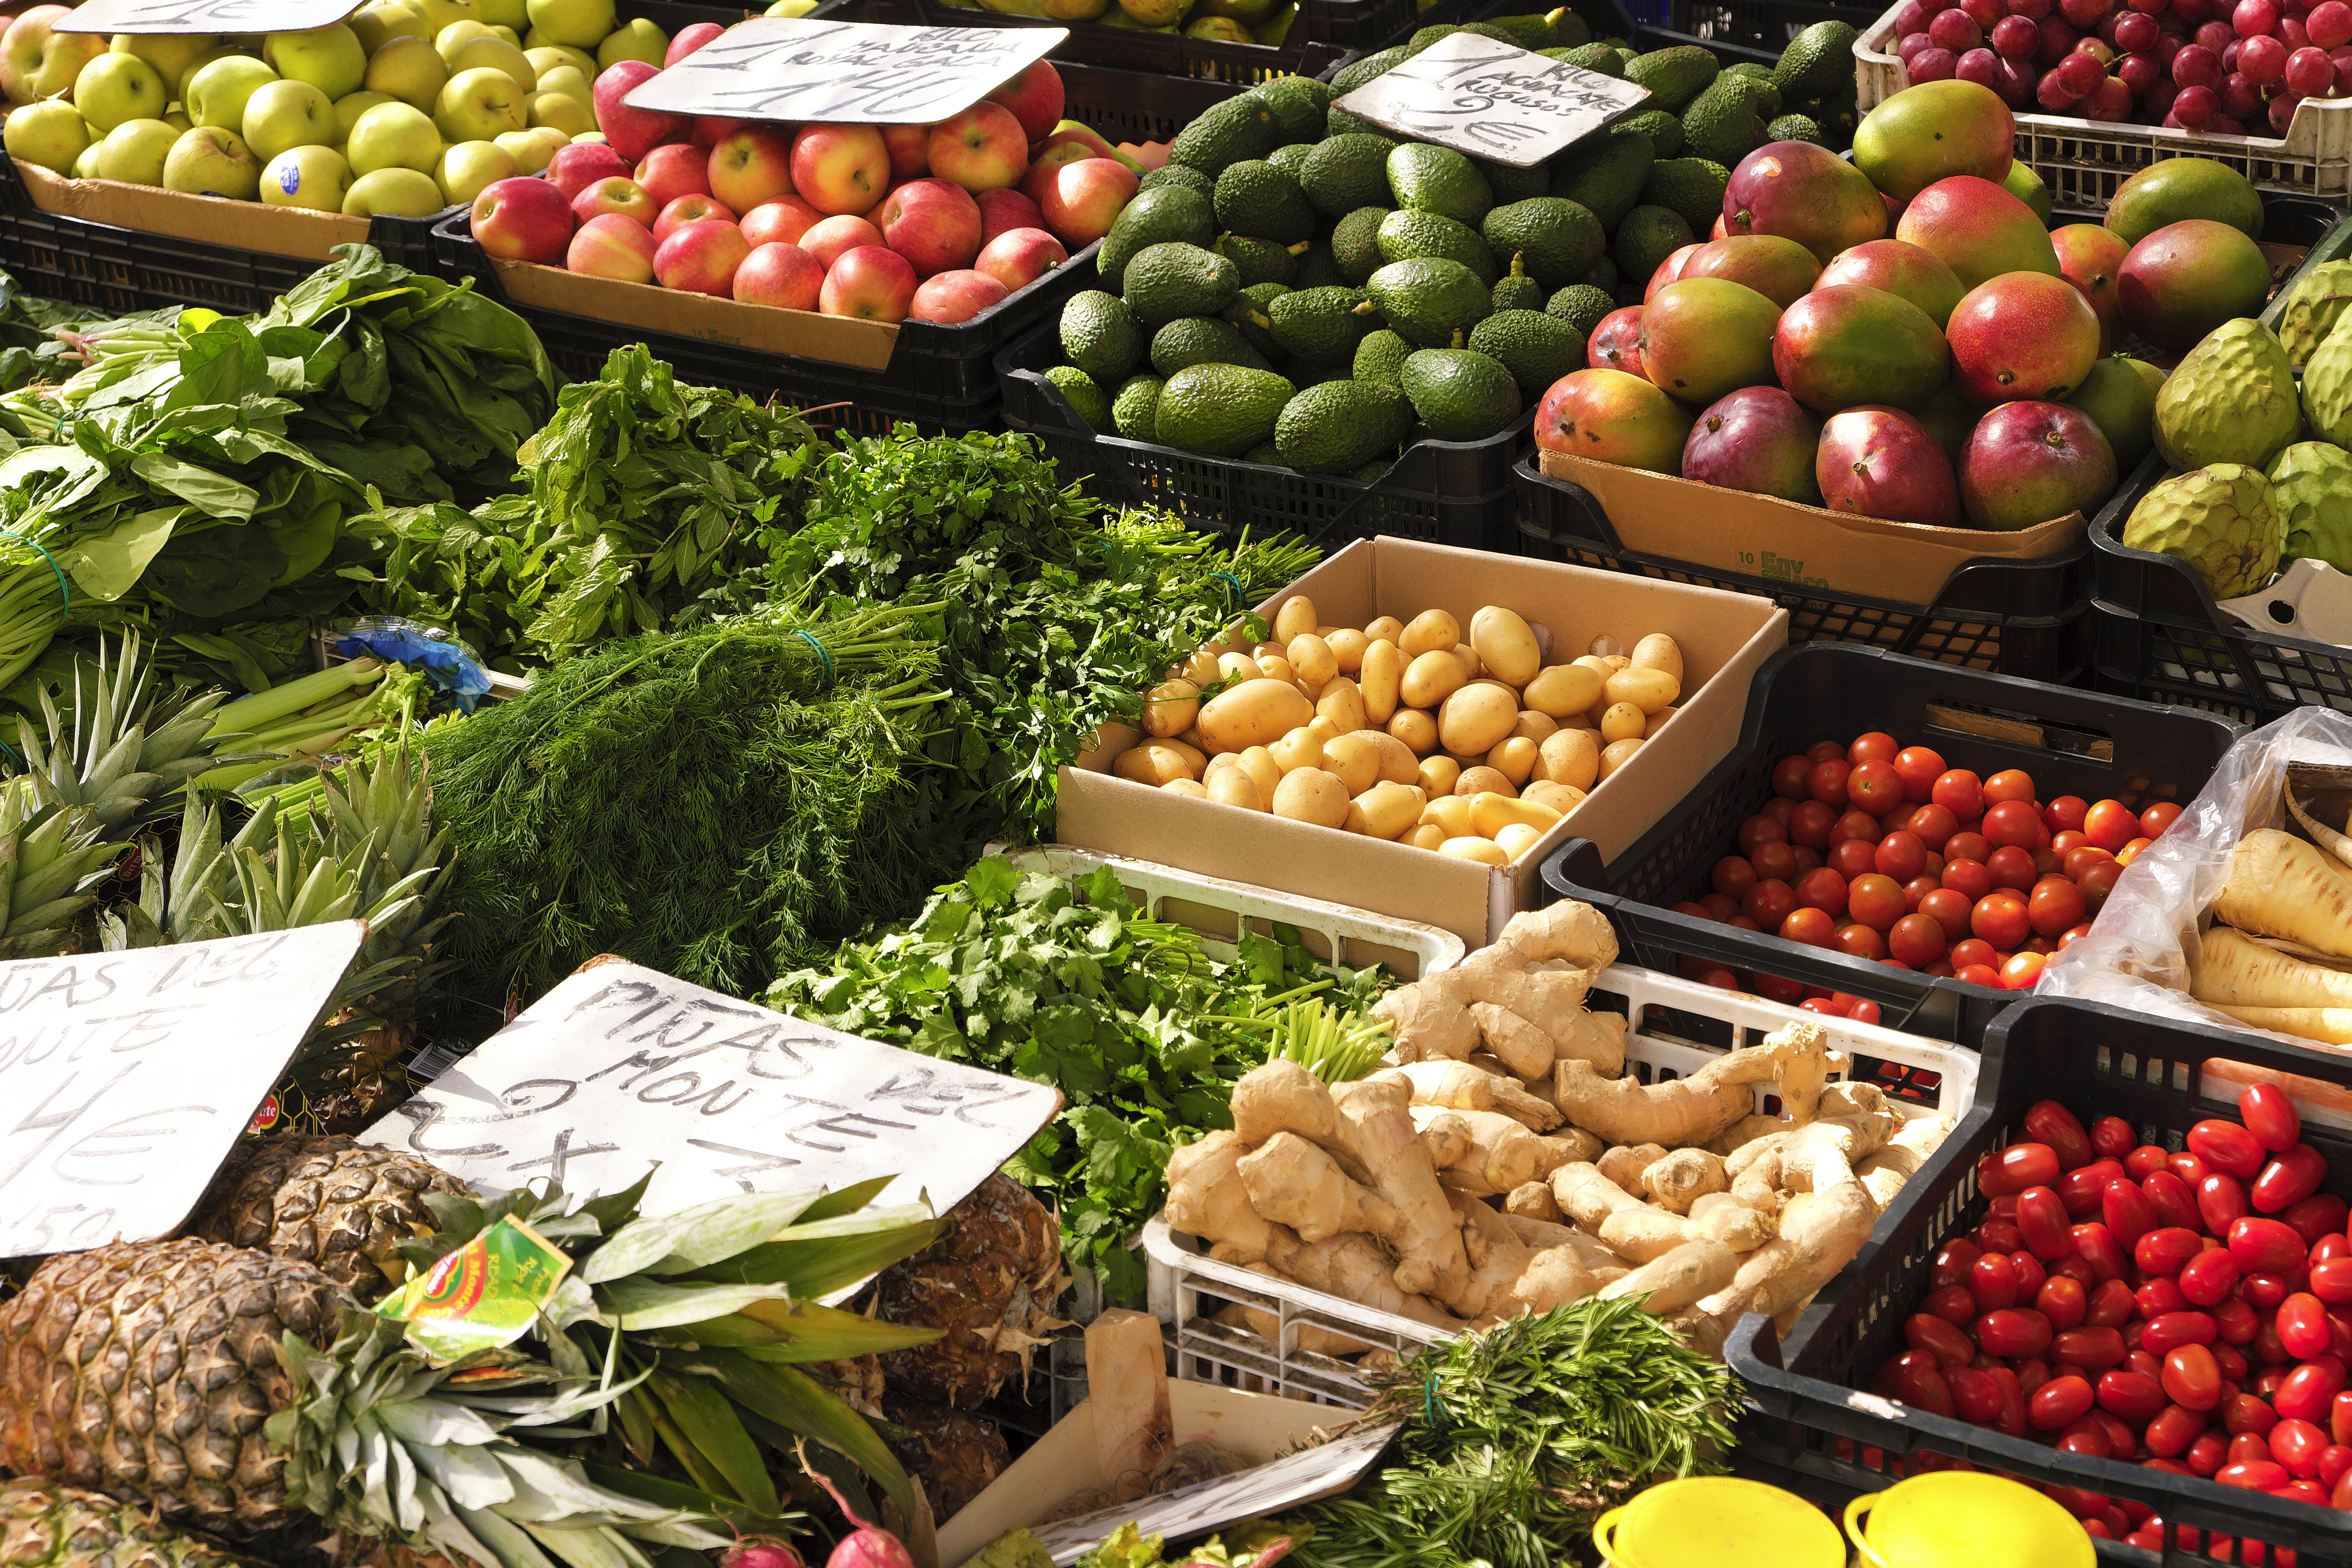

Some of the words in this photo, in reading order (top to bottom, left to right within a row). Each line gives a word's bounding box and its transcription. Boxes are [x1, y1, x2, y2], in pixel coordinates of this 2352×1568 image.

[782, 51, 889, 66] ROYAL
[891, 55, 1002, 69] GALA
[1532, 62, 1616, 89] KILO
[1739, 551, 1754, 564] 10
[147, 934, 290, 998] DEL
[563, 979, 840, 1080] PIÑAS
[864, 1067, 1032, 1130] DEL
[259, 1105, 276, 1117] nte
[585, 1050, 917, 1152] MONTE
[454, 1259, 482, 1311] Monte
[485, 1254, 502, 1307] READY
